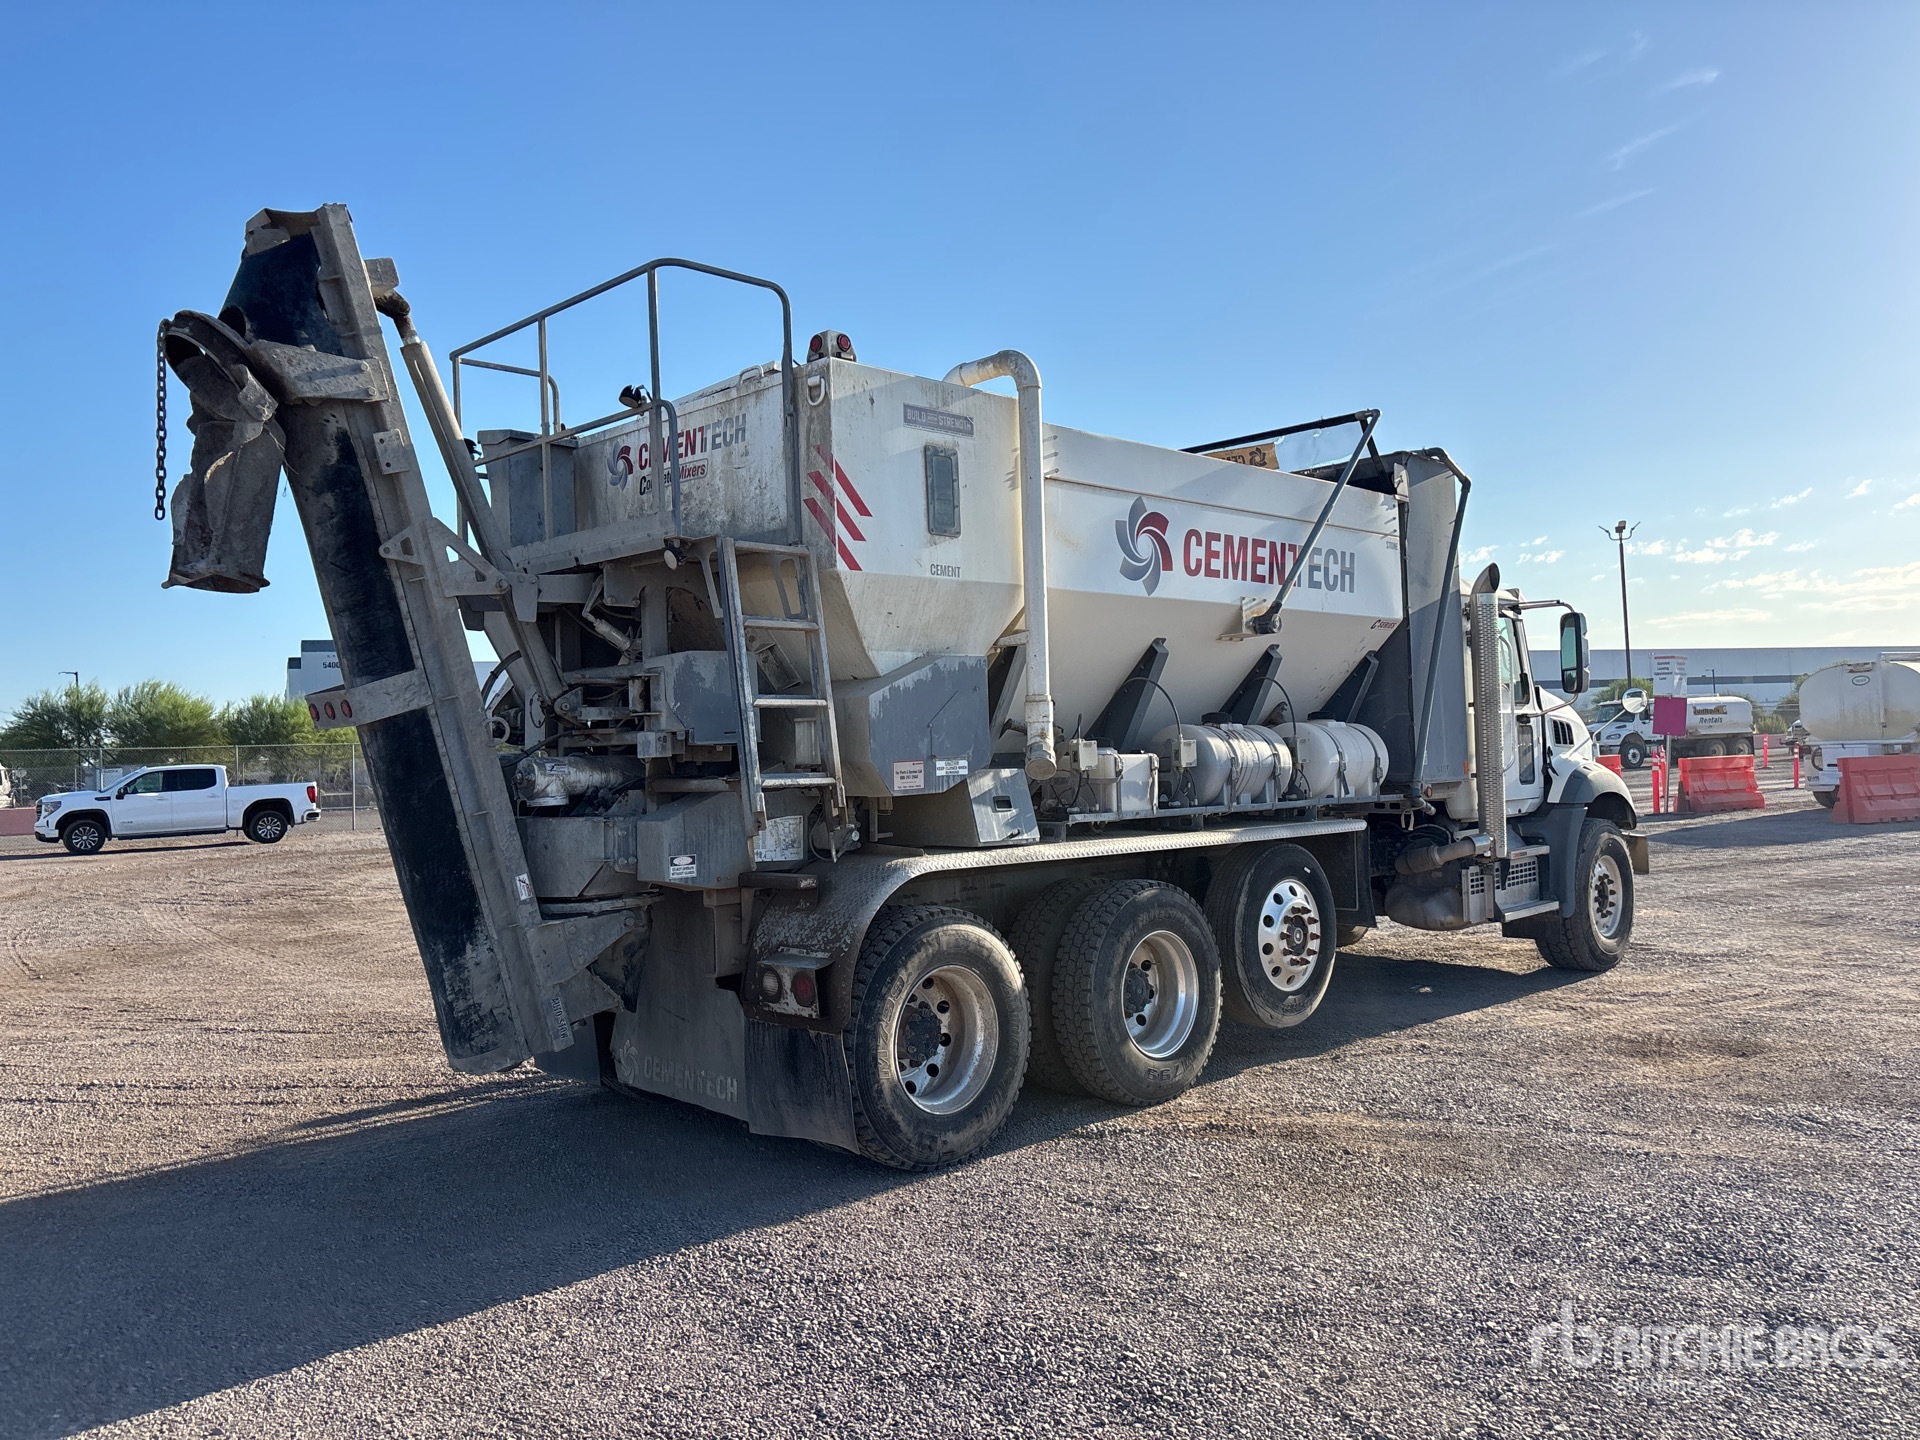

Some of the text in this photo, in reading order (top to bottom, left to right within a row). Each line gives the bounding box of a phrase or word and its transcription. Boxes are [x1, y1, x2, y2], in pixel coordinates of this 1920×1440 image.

[907, 408, 926, 422] BUILD
[938, 415, 971, 431] STRENGTH
[930, 563, 961, 578] CEMENT
[1698, 716, 1723, 724] Rentals
[878, 974, 905, 1079] M799
